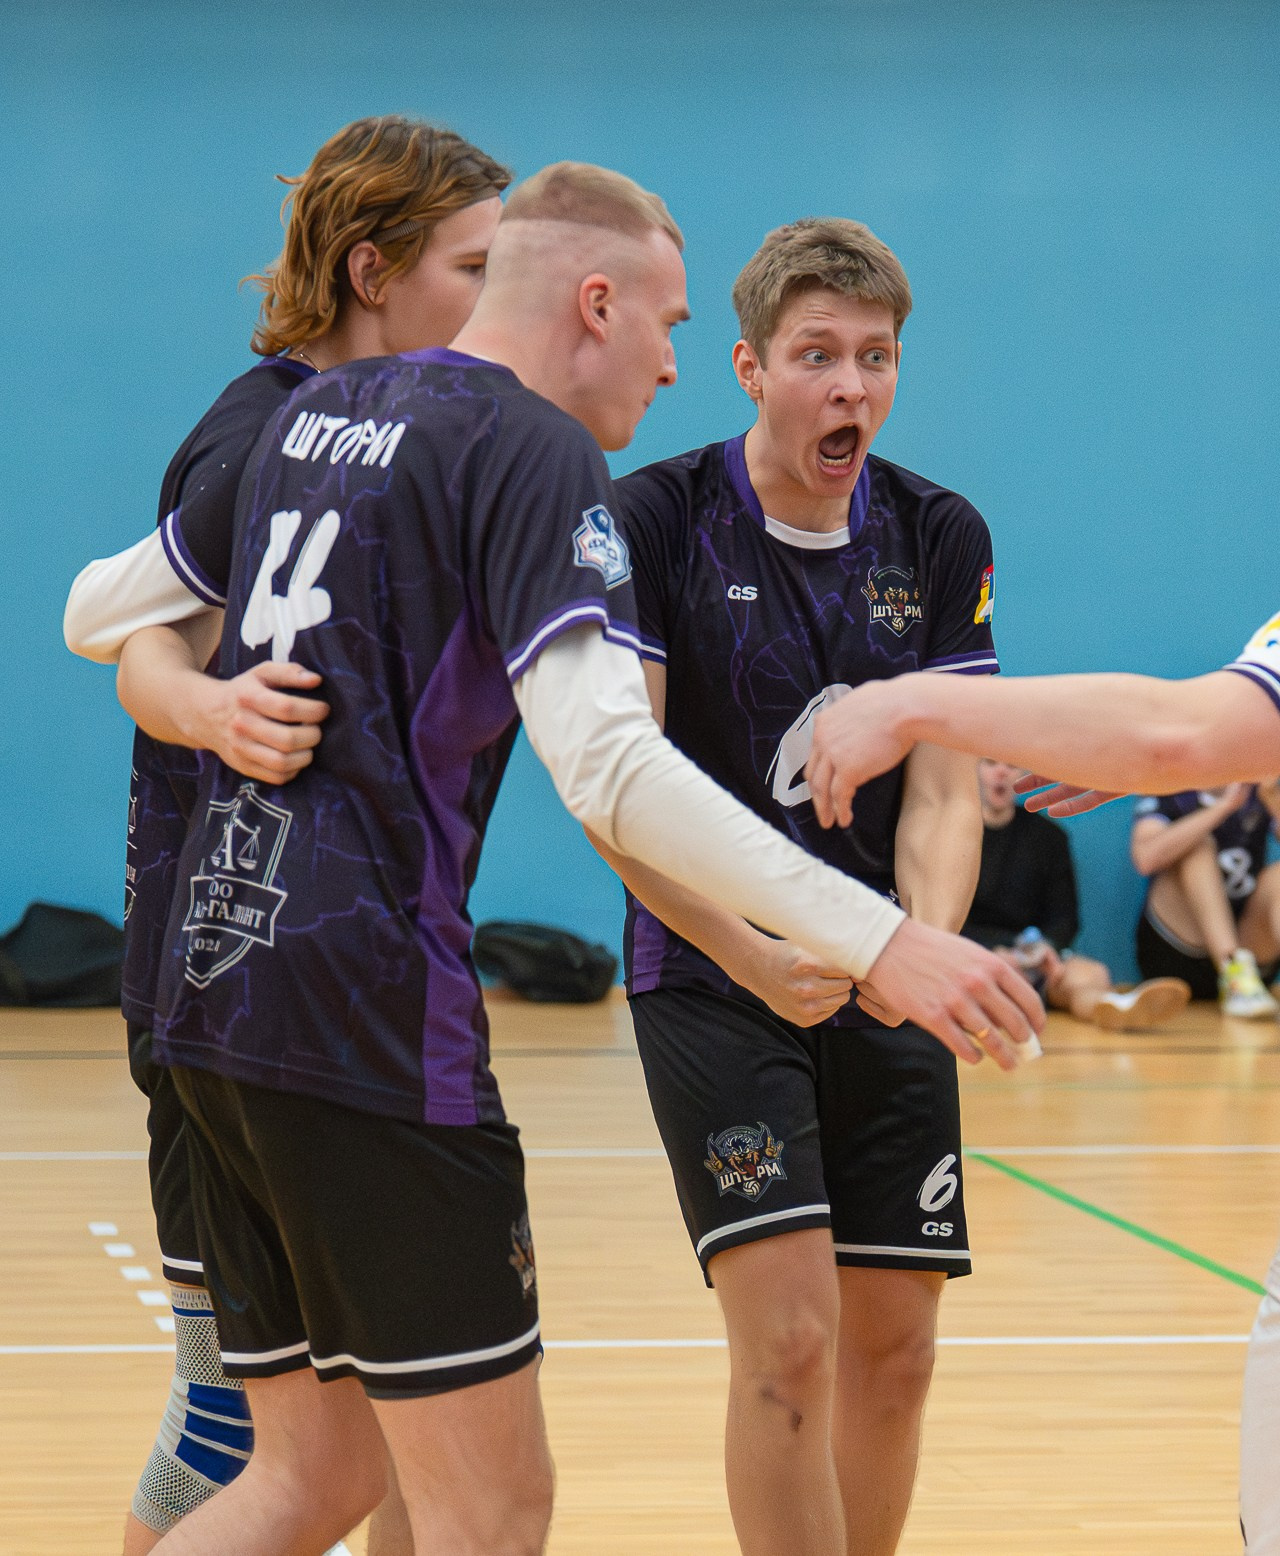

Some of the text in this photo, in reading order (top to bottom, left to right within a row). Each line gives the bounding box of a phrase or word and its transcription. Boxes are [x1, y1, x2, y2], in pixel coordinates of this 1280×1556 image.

[240, 509, 341, 663] 4
[727, 584, 758, 601] GS
[872, 604, 922, 619] ШТРМ
[719, 1162, 782, 1190] ШТРМ
[916, 1153, 958, 1212] 6
[921, 1221, 954, 1237] GS
